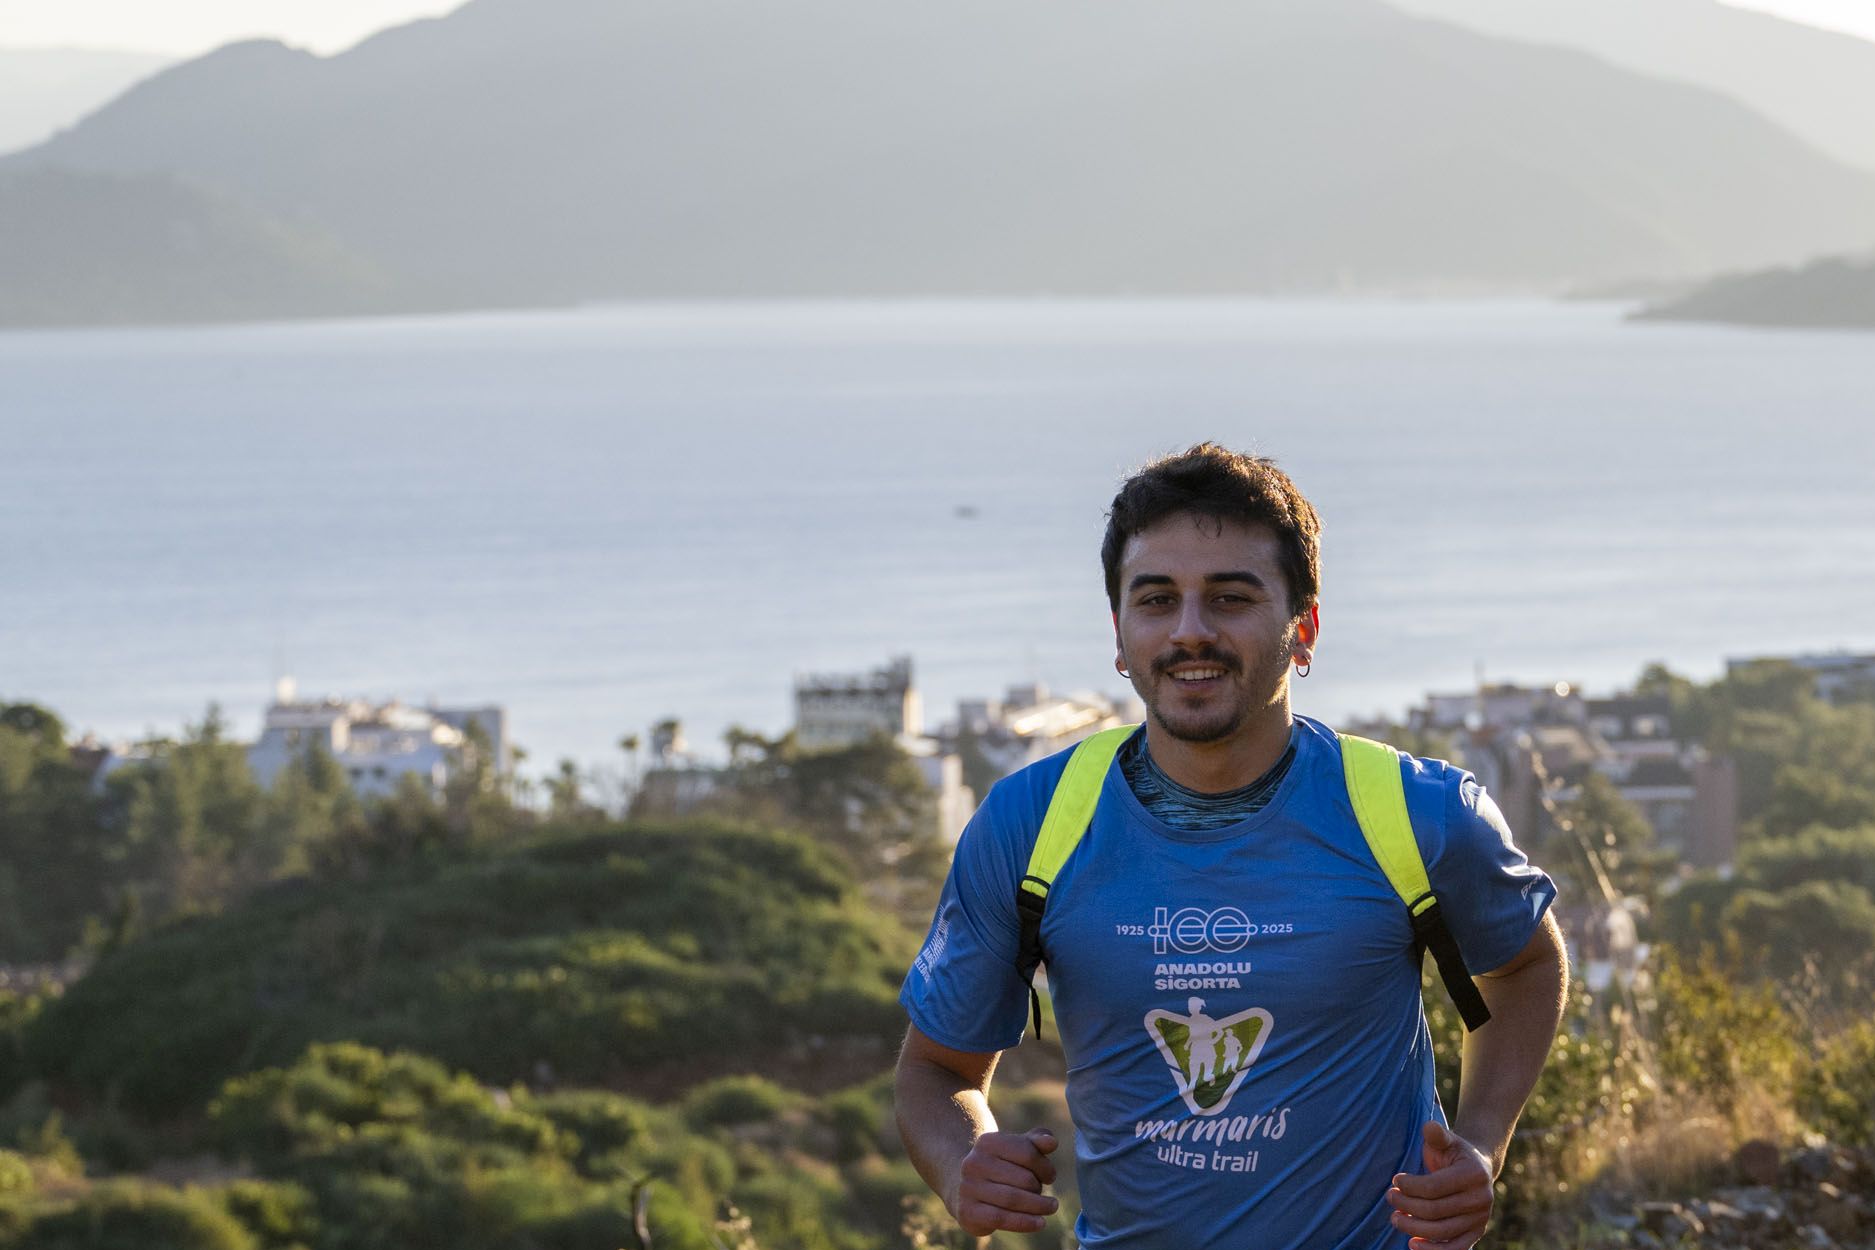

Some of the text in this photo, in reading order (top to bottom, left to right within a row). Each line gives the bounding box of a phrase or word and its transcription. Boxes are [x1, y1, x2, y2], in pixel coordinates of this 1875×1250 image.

[1115, 925, 1144, 936] 1925
[1261, 923, 1293, 934] 2025
[1154, 962, 1251, 975] ANADOLU
[1154, 976, 1241, 990] SİGORTA
[1135, 1107, 1291, 1147] marmaris
[1157, 1144, 1259, 1172] ultra trail
